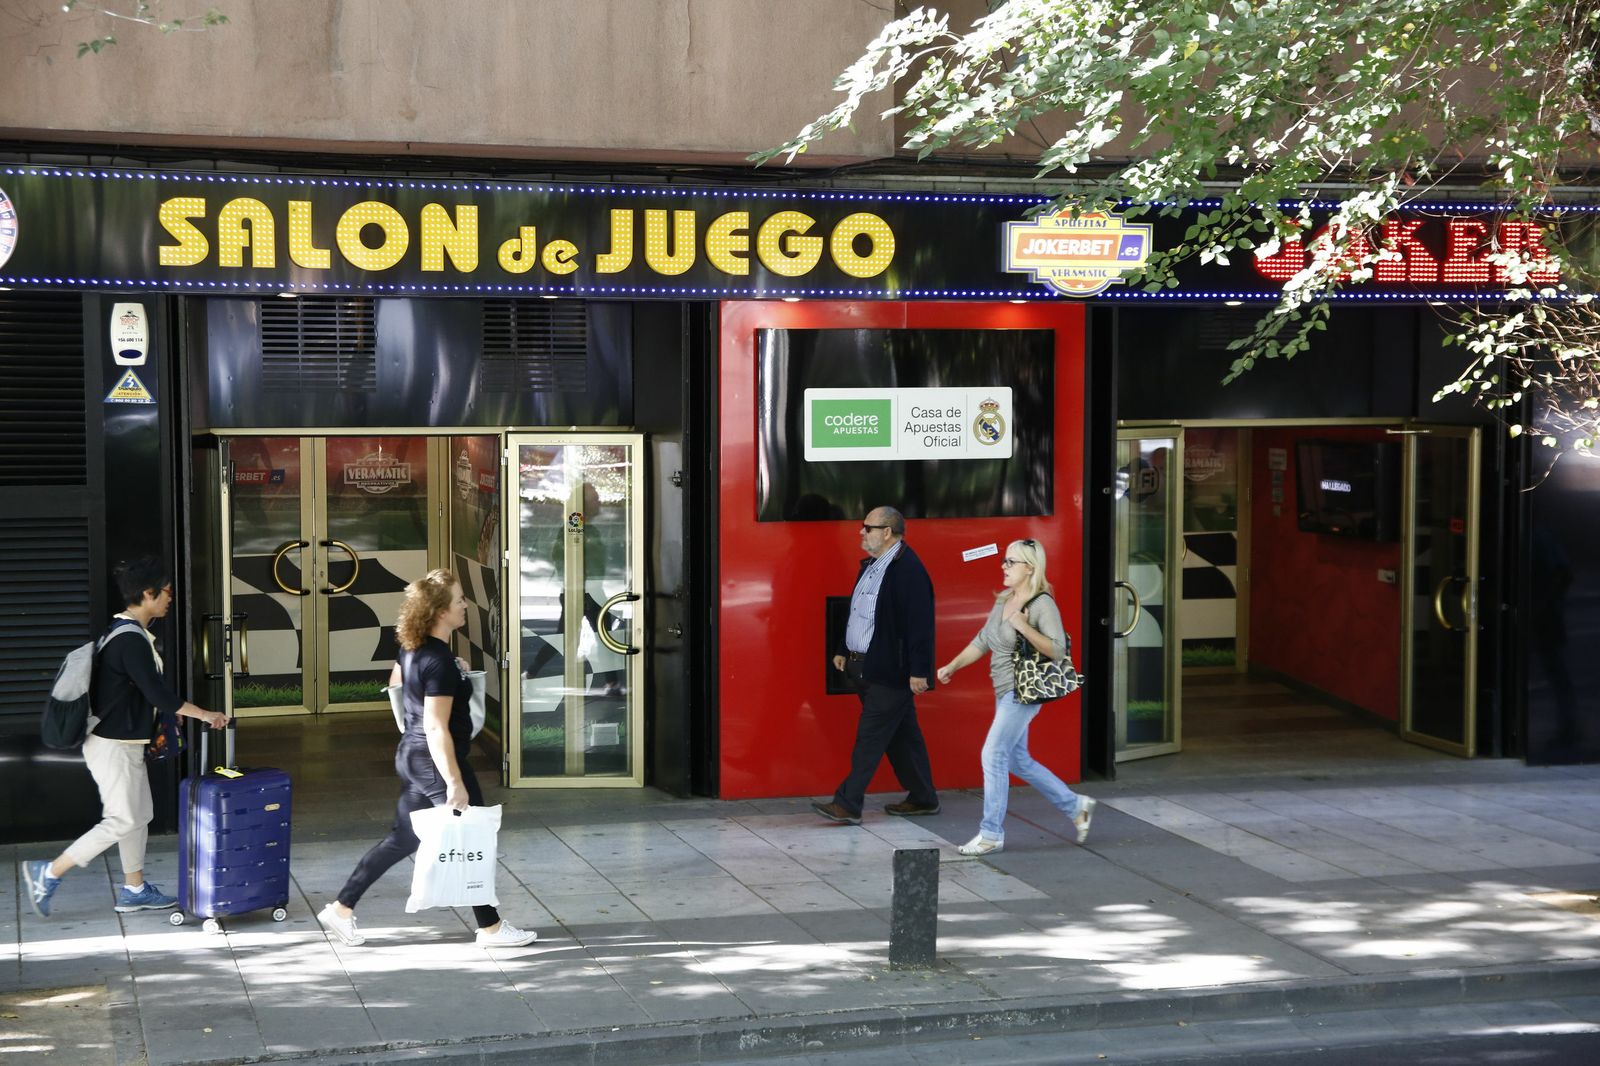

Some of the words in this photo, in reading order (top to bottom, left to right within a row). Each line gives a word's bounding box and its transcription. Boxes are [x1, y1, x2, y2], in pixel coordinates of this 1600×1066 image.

[158, 197, 479, 273] SALON
[497, 226, 580, 276] de
[595, 208, 896, 279] JUEGO
[1023, 239, 1114, 256] JOKERBET
[1120, 246, 1139, 257] .es
[1052, 269, 1107, 278] VERAMATIC
[911, 406, 942, 418] Casa
[946, 406, 961, 418] de
[824, 413, 879, 427] codere
[833, 427, 879, 435] APUESTAS
[904, 421, 961, 434] Apuestas
[923, 435, 961, 447] Oficial
[235, 472, 266, 481] ERBET
[347, 467, 407, 480] VERAMATIC
